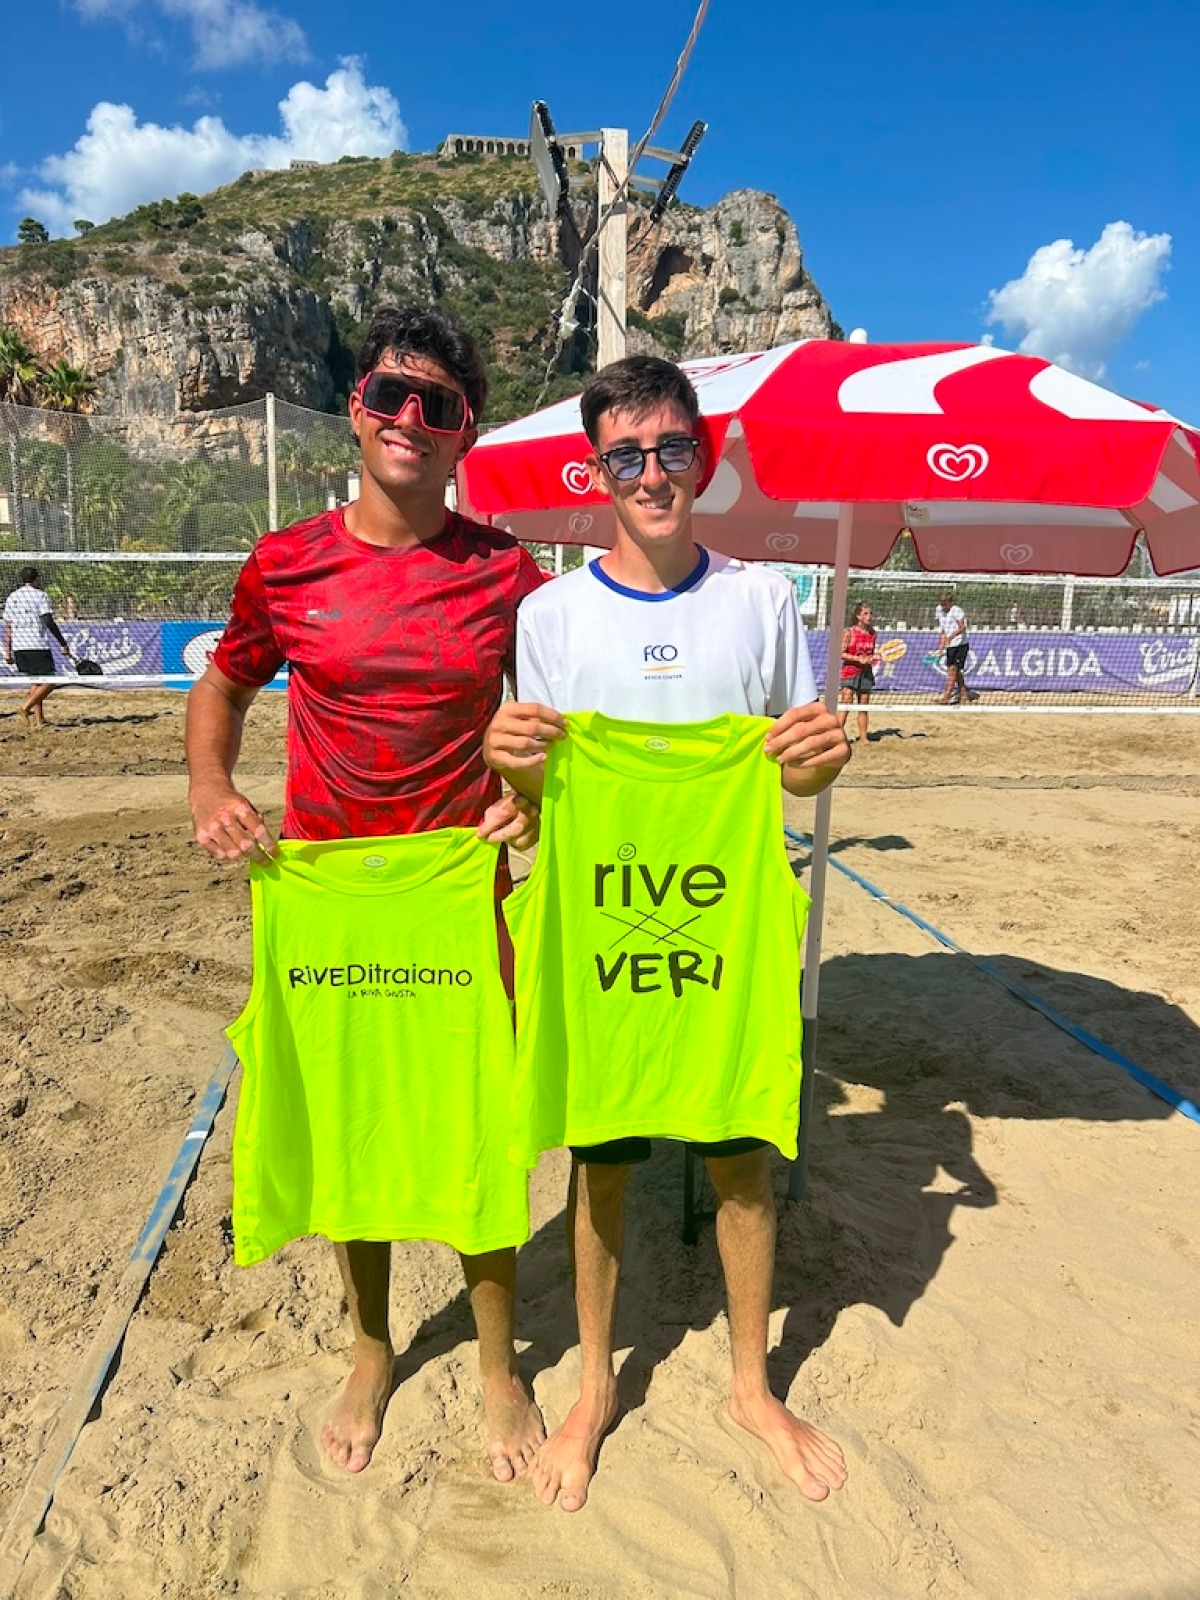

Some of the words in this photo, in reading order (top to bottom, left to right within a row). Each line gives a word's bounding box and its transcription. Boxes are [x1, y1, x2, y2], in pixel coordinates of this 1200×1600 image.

[643, 644, 678, 661] FCO
[977, 649, 1103, 677] ALGIDA
[594, 843, 727, 908] rive
[594, 950, 724, 998] VERI
